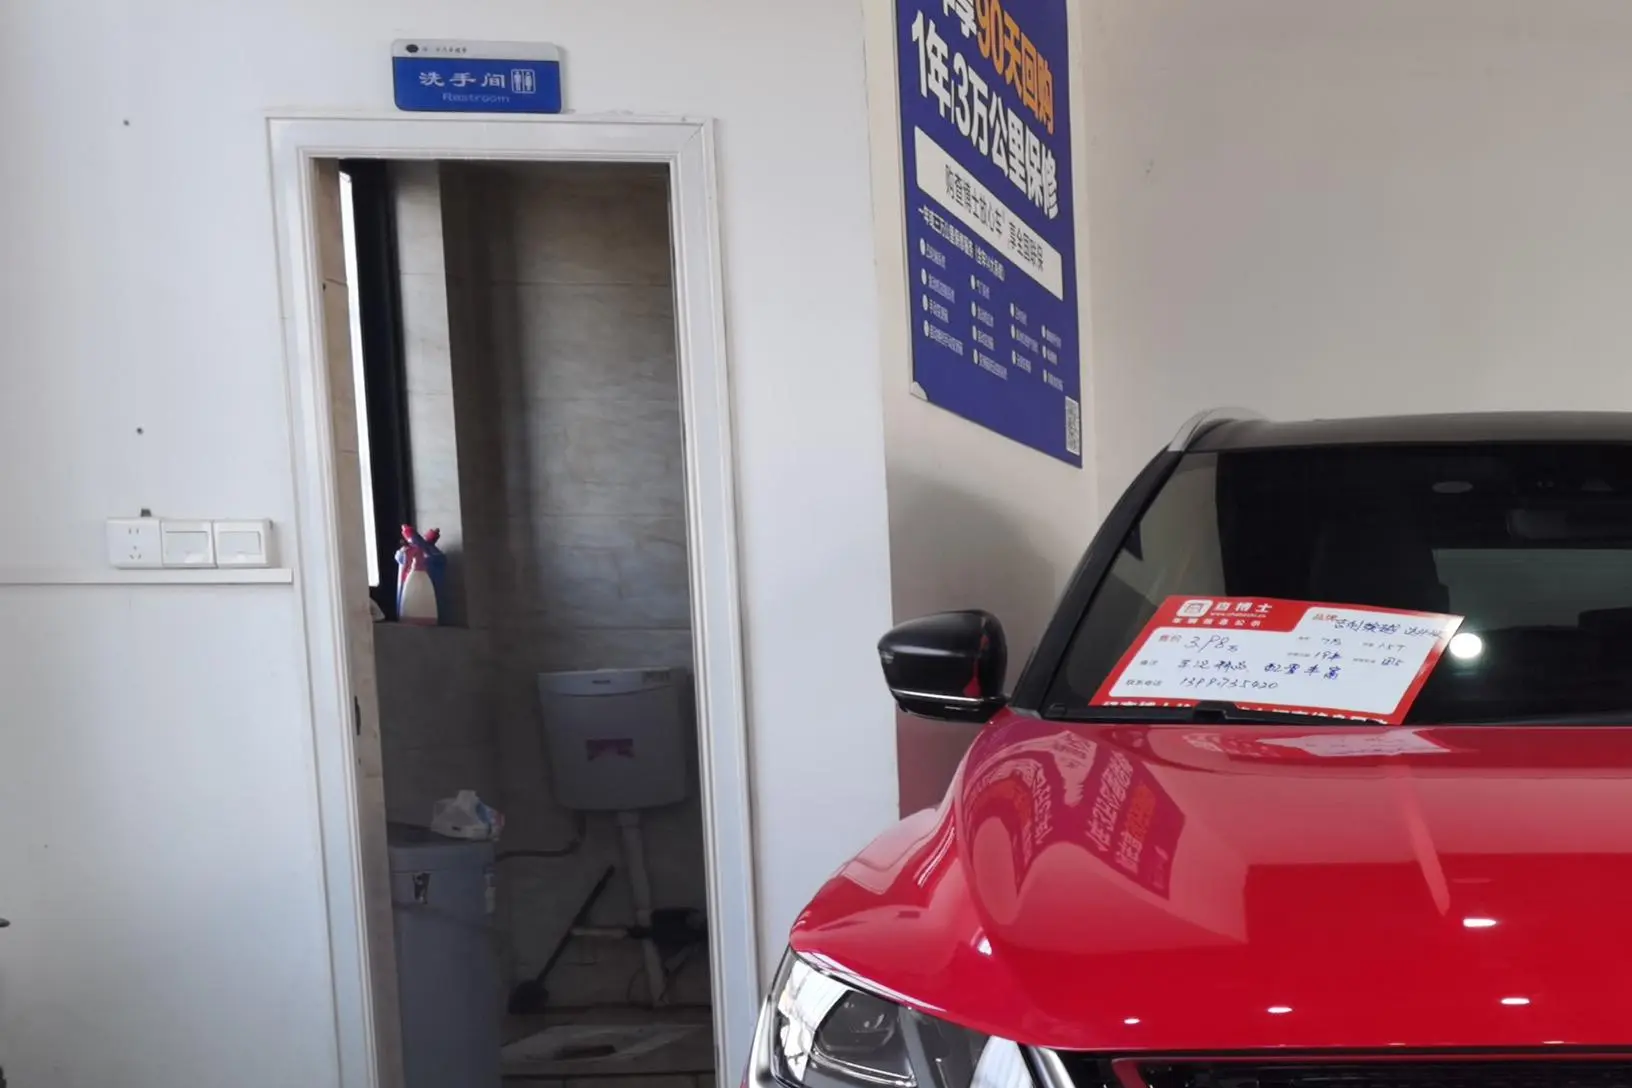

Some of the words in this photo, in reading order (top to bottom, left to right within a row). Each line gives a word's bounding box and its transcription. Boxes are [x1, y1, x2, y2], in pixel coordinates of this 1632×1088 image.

[418, 72, 506, 88] 洗手间
[1214, 601, 1272, 613] 查博士
